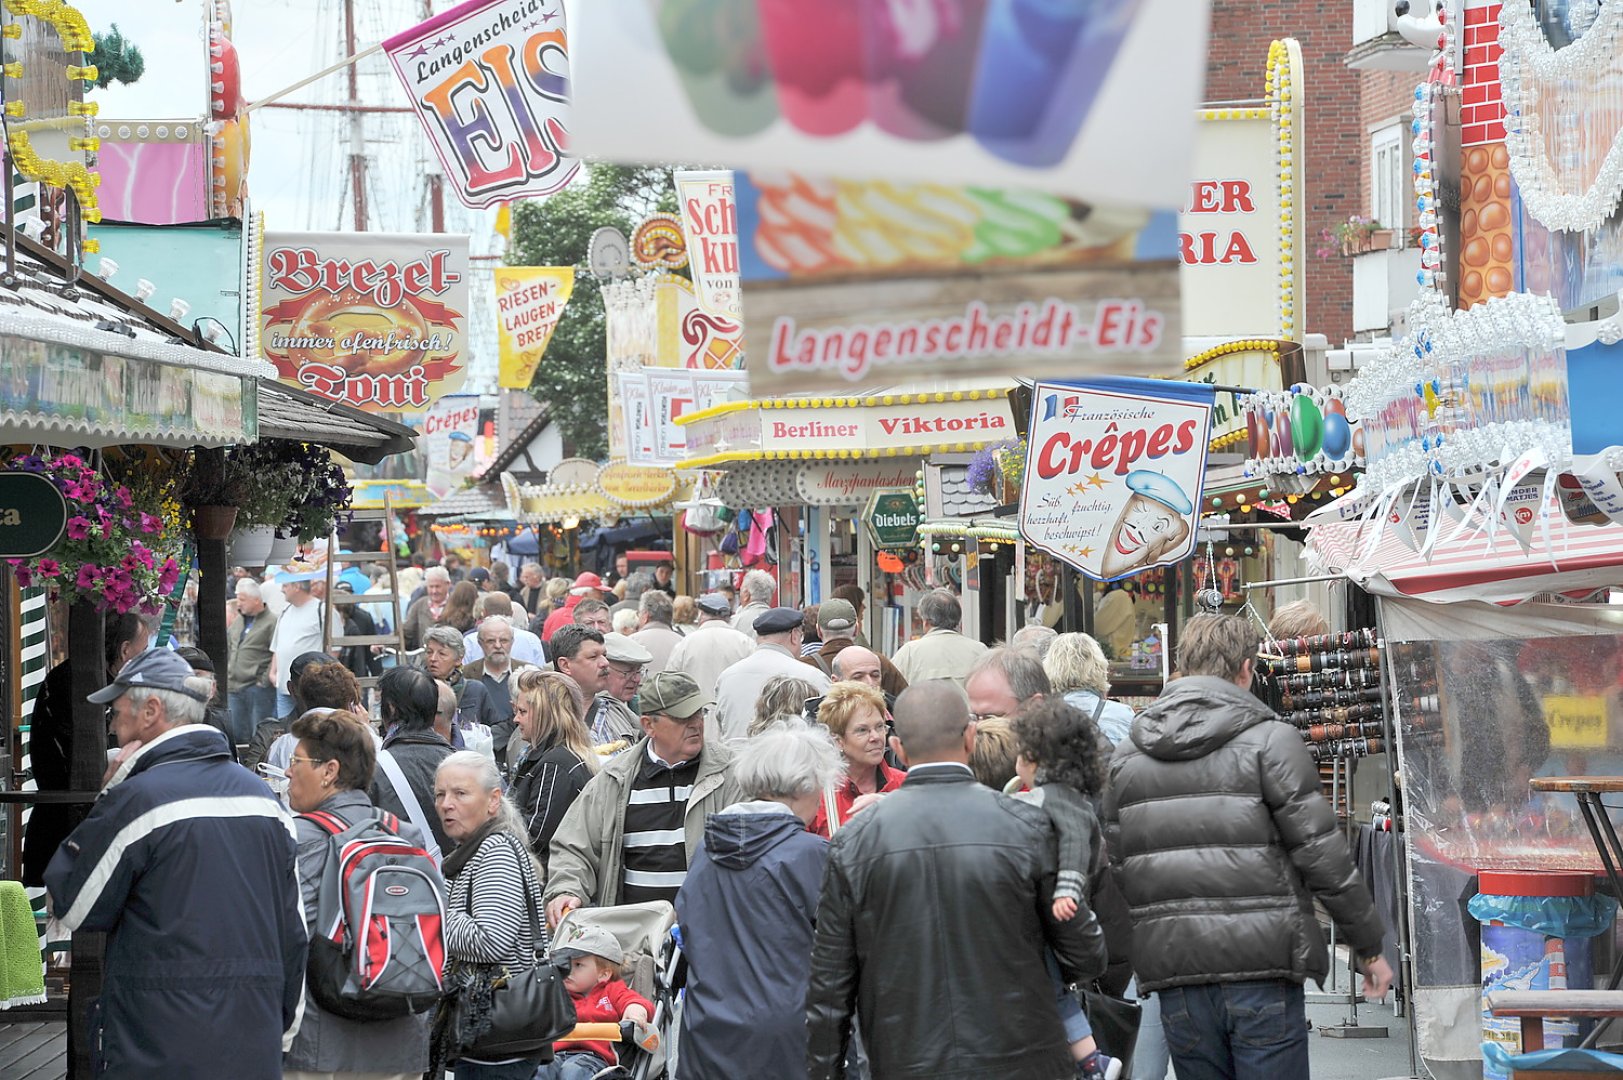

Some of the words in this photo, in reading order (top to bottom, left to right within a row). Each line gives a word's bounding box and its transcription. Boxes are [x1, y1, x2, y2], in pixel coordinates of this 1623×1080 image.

[421, 27, 571, 197] EIS
[1180, 181, 1255, 212] ER
[687, 198, 738, 236] Sch
[701, 237, 739, 274] ku
[268, 247, 461, 308] Brezel-
[707, 279, 733, 289] von
[497, 281, 557, 313] RIESEN-
[505, 301, 564, 331] LAUGEN-
[271, 331, 336, 350] immer
[340, 331, 452, 355] ofenfrisch!
[773, 301, 1162, 376] Langenscheidt-Eis
[298, 363, 428, 406] Toni
[773, 421, 858, 438] Berliner
[878, 411, 1007, 435] Viktoria
[1066, 405, 1155, 423] Französische
[1037, 420, 1197, 479] Crêpes
[875, 512, 917, 527] Diebels
